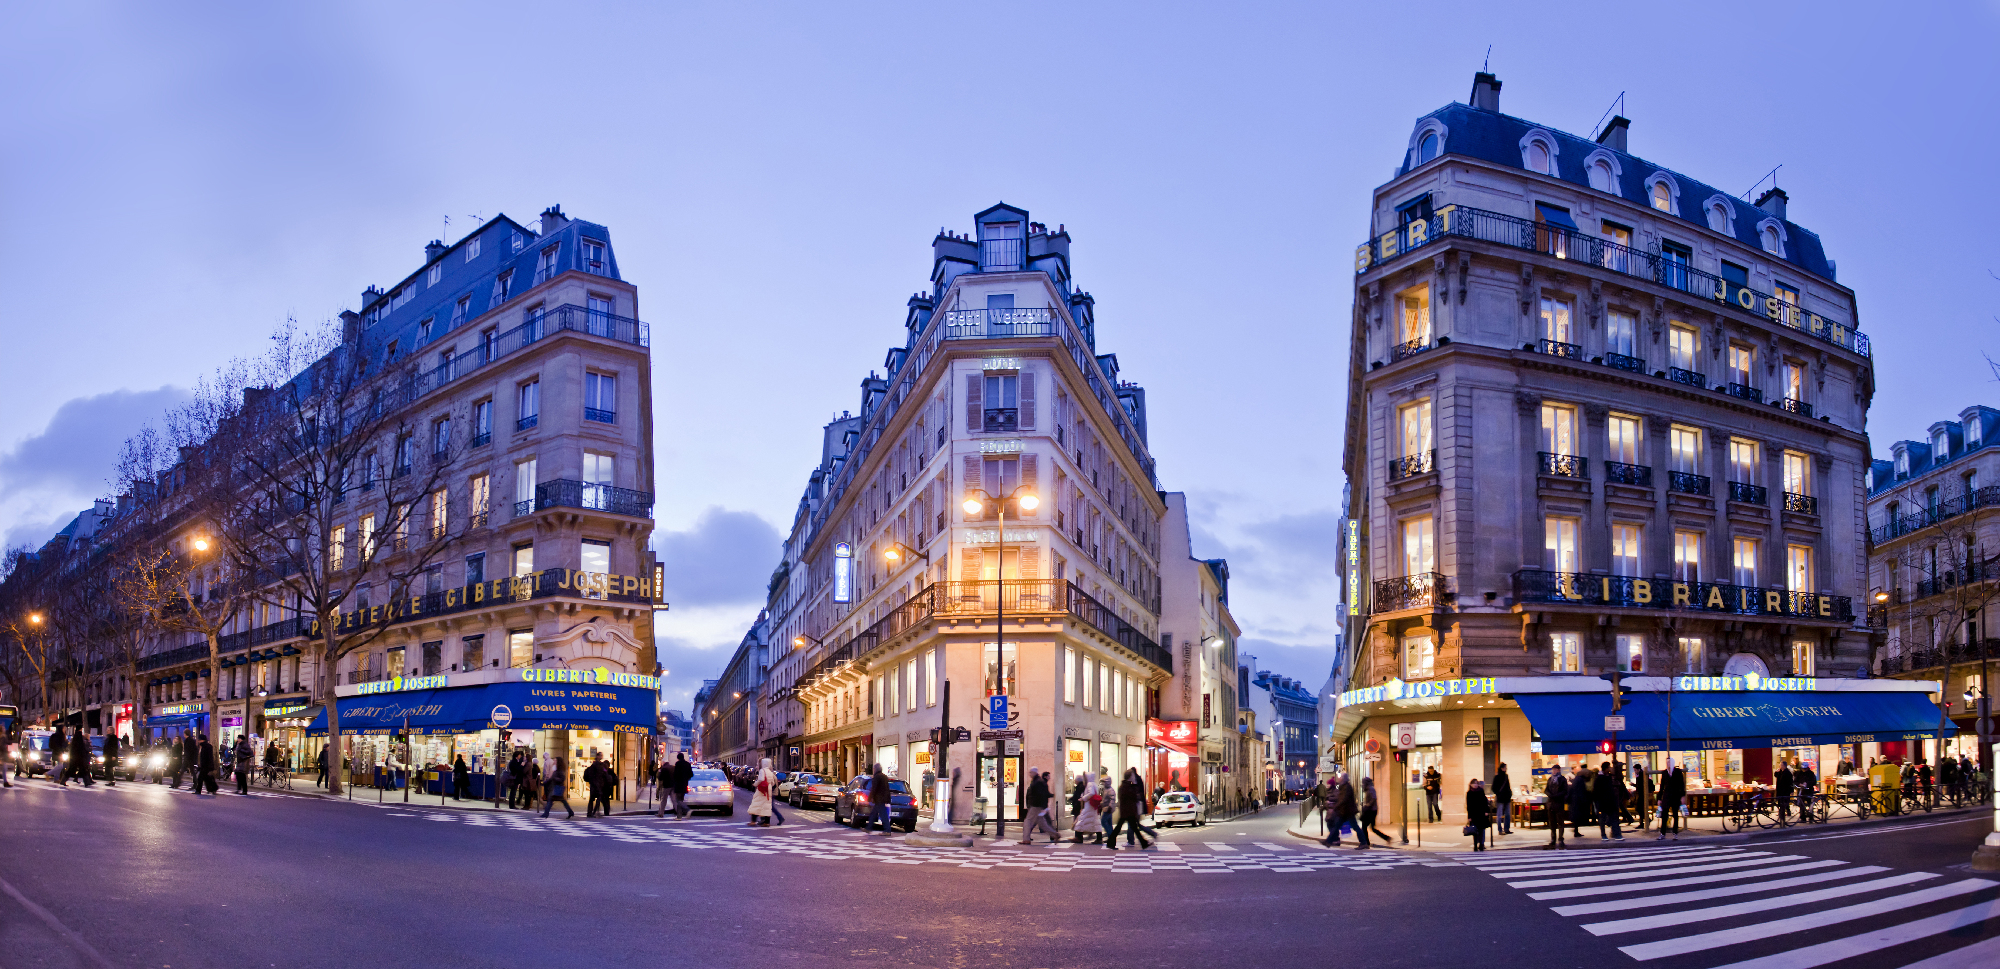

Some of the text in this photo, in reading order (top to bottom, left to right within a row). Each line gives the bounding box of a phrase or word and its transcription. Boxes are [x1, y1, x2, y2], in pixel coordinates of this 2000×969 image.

[1355, 205, 1455, 271] BERT
[946, 312, 980, 326] Best
[1714, 279, 1845, 345] JOSEPH
[1349, 520, 1358, 615] GIBERT JOSEPH
[839, 559, 847, 596] HOTEL
[312, 568, 650, 636] PPETERIE GIBERT JOSEPH
[1566, 574, 1831, 616] LIBRAIRIE
[358, 675, 447, 694] GIBERT JOSEPH
[522, 669, 660, 690] GIBERT JOSEPH
[1680, 676, 1816, 690] GIBERT JOSEPH
[532, 689, 618, 700] LIVRES PAPETERIE
[1342, 686, 1384, 706] GIBERT
[1406, 678, 1496, 698] JOSEPH
[343, 704, 443, 718] GIBERT JOSEPH
[524, 704, 566, 712] DISQUES
[610, 706, 626, 714] DVD
[994, 699, 1002, 710] P
[1693, 706, 1843, 717] GIBERT JOSEPH
[614, 724, 649, 734] OCCASION
[1170, 730, 1190, 738] DVD
[1702, 740, 1733, 749] LIVRES
[1772, 737, 1812, 746] PAPETERIE
[1846, 734, 1875, 742] DISQUES
